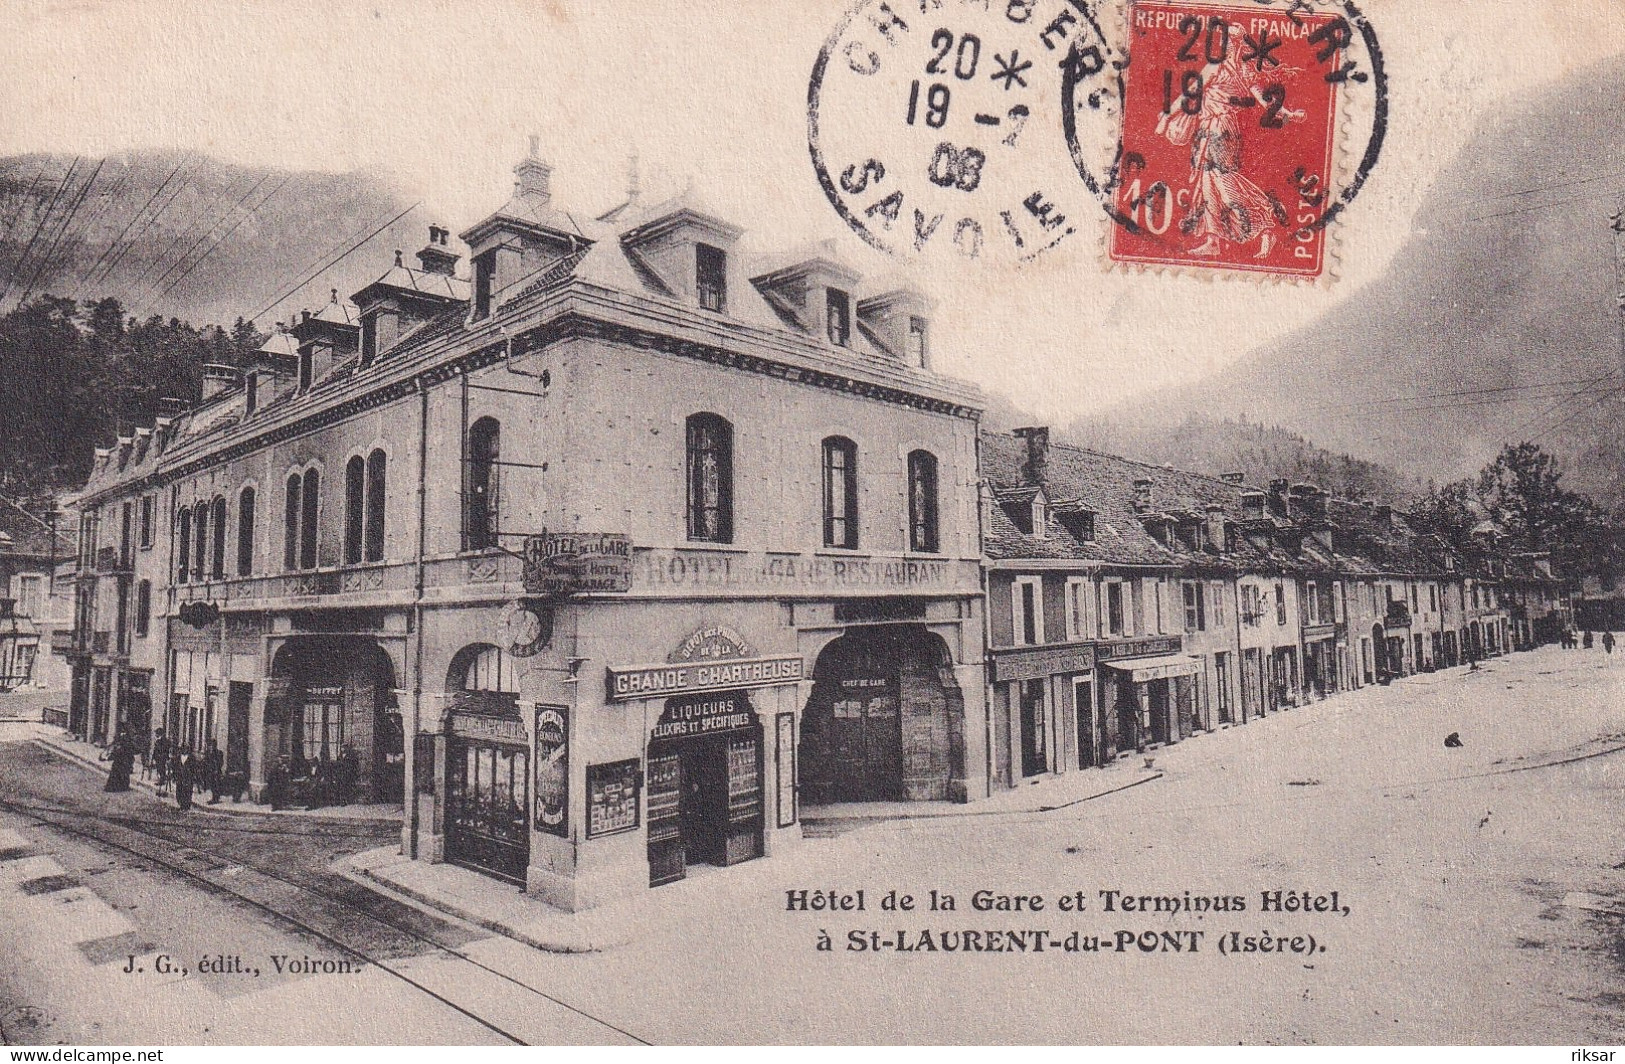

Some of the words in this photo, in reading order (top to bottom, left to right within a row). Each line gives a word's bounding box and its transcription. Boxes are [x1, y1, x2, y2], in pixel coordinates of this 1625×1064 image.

[926, 27, 981, 81] 20
[1176, 15, 1229, 65] 20
[906, 79, 951, 129] 19
[839, 157, 1066, 260] SAVOIE
[832, 560, 949, 585] RESTAURANT
[617, 669, 688, 693] GRANDE
[698, 660, 801, 687] CHARTREUSE
[671, 700, 734, 719] LIQUEURS
